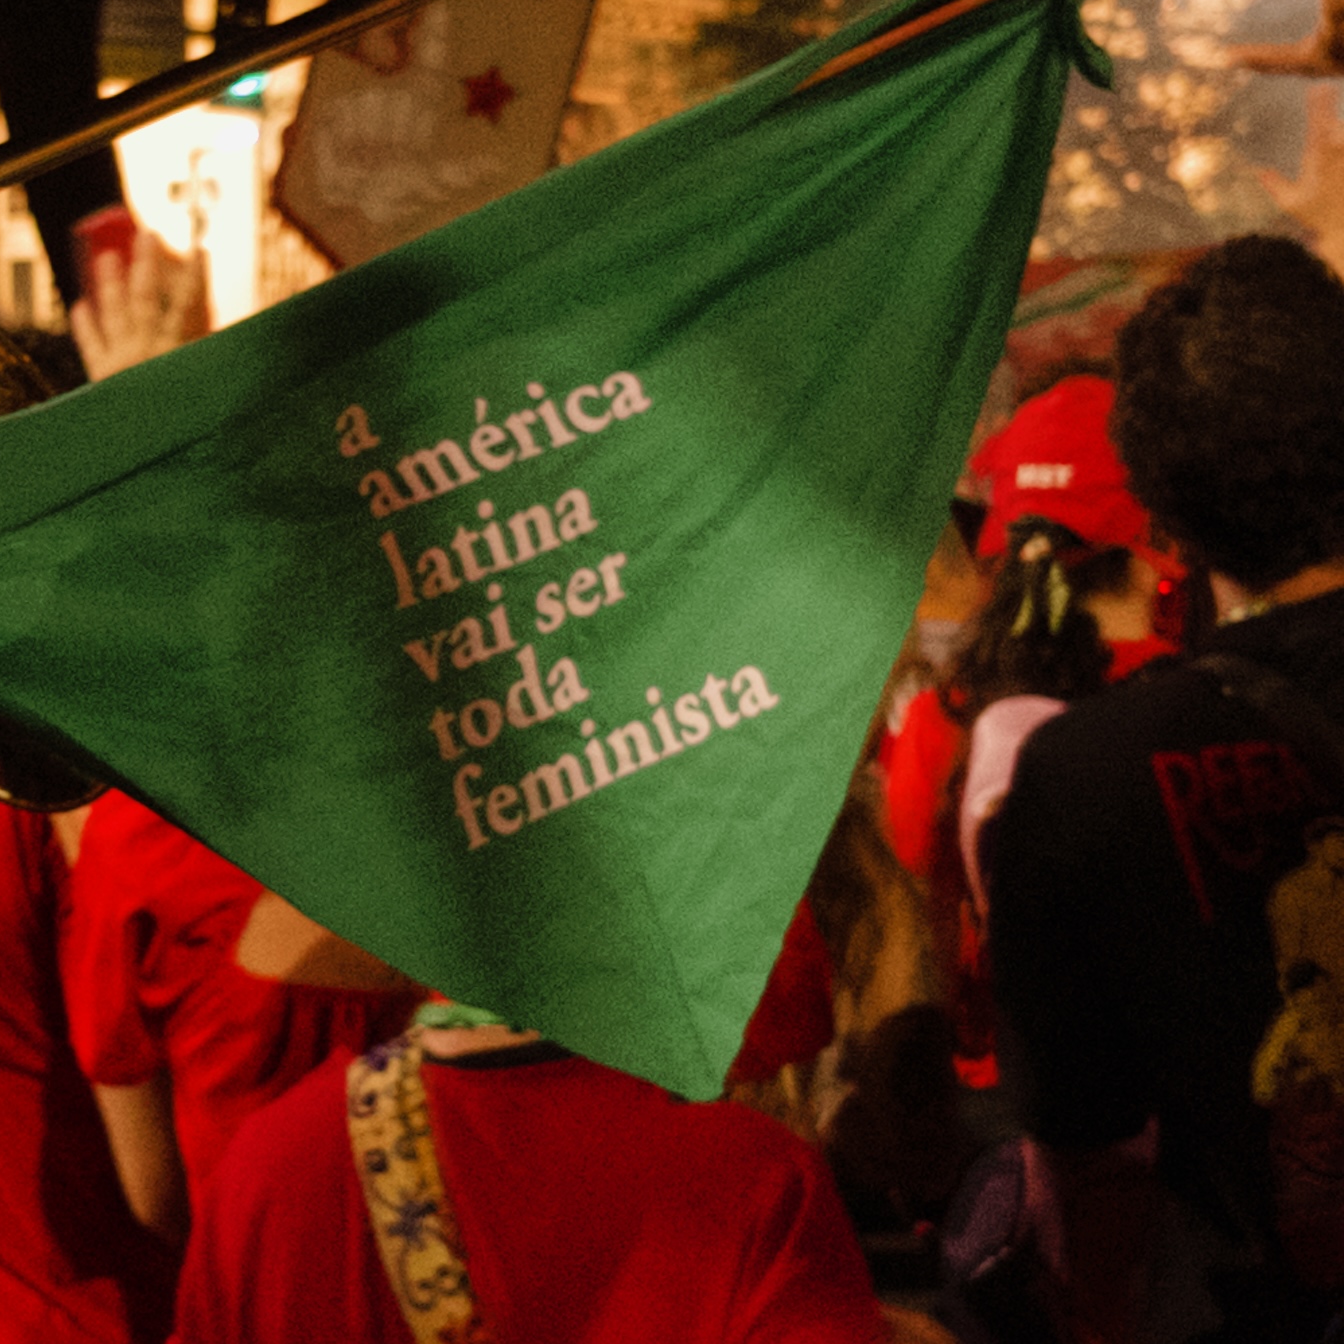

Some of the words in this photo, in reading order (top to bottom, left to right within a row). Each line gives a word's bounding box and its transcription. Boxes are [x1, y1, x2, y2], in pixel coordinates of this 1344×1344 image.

[335, 403, 381, 457] a
[358, 370, 653, 518] américa
[379, 488, 598, 609] latina
[403, 583, 517, 682] vai
[534, 552, 627, 634] ser
[429, 643, 590, 761] toda
[453, 665, 780, 851] feminista
